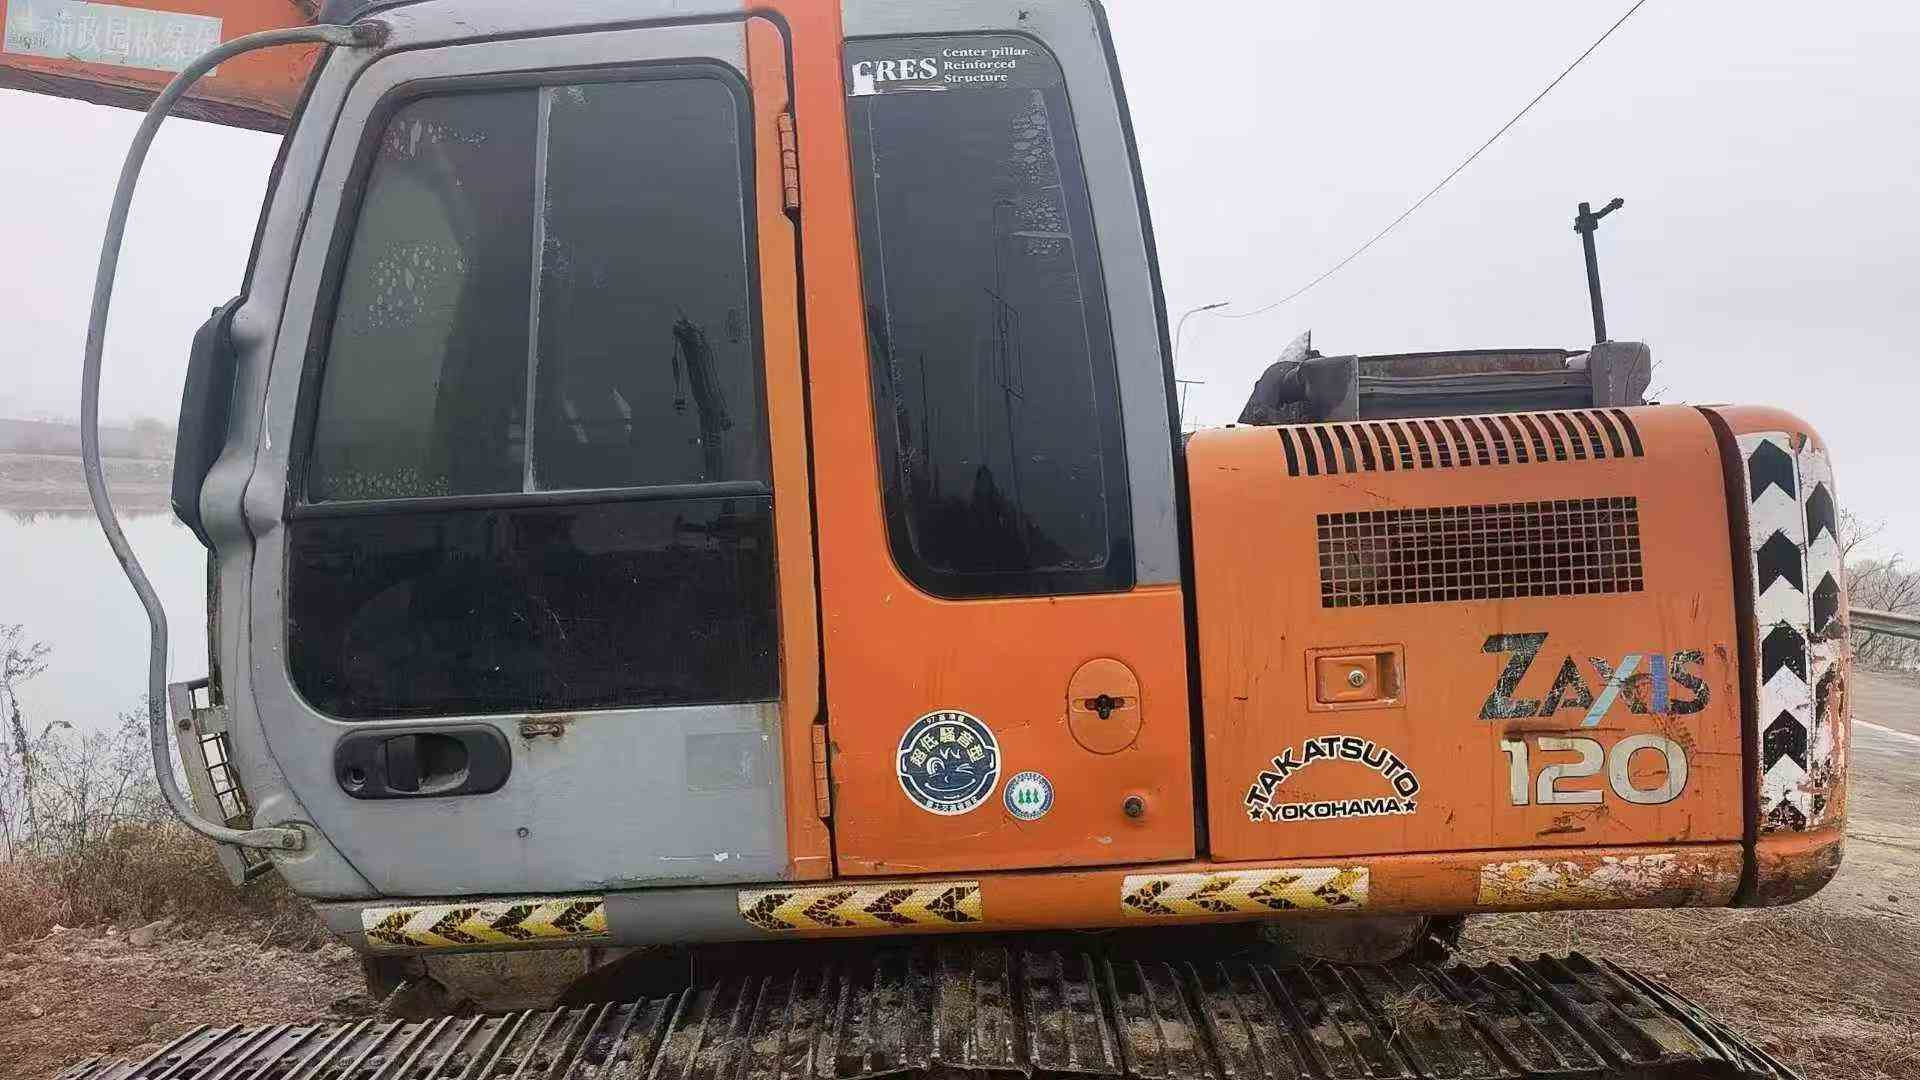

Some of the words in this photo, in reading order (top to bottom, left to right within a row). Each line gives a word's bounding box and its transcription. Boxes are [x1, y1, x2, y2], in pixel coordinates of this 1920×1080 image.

[943, 47, 987, 58] Center
[992, 46, 1028, 58] pillar
[944, 59, 1017, 70] Reinforced
[944, 73, 1008, 84] Structure
[1247, 736, 1420, 806] TAKATSUTO
[1500, 734, 1689, 806] 120
[1266, 799, 1401, 821] YOKOHAMA
